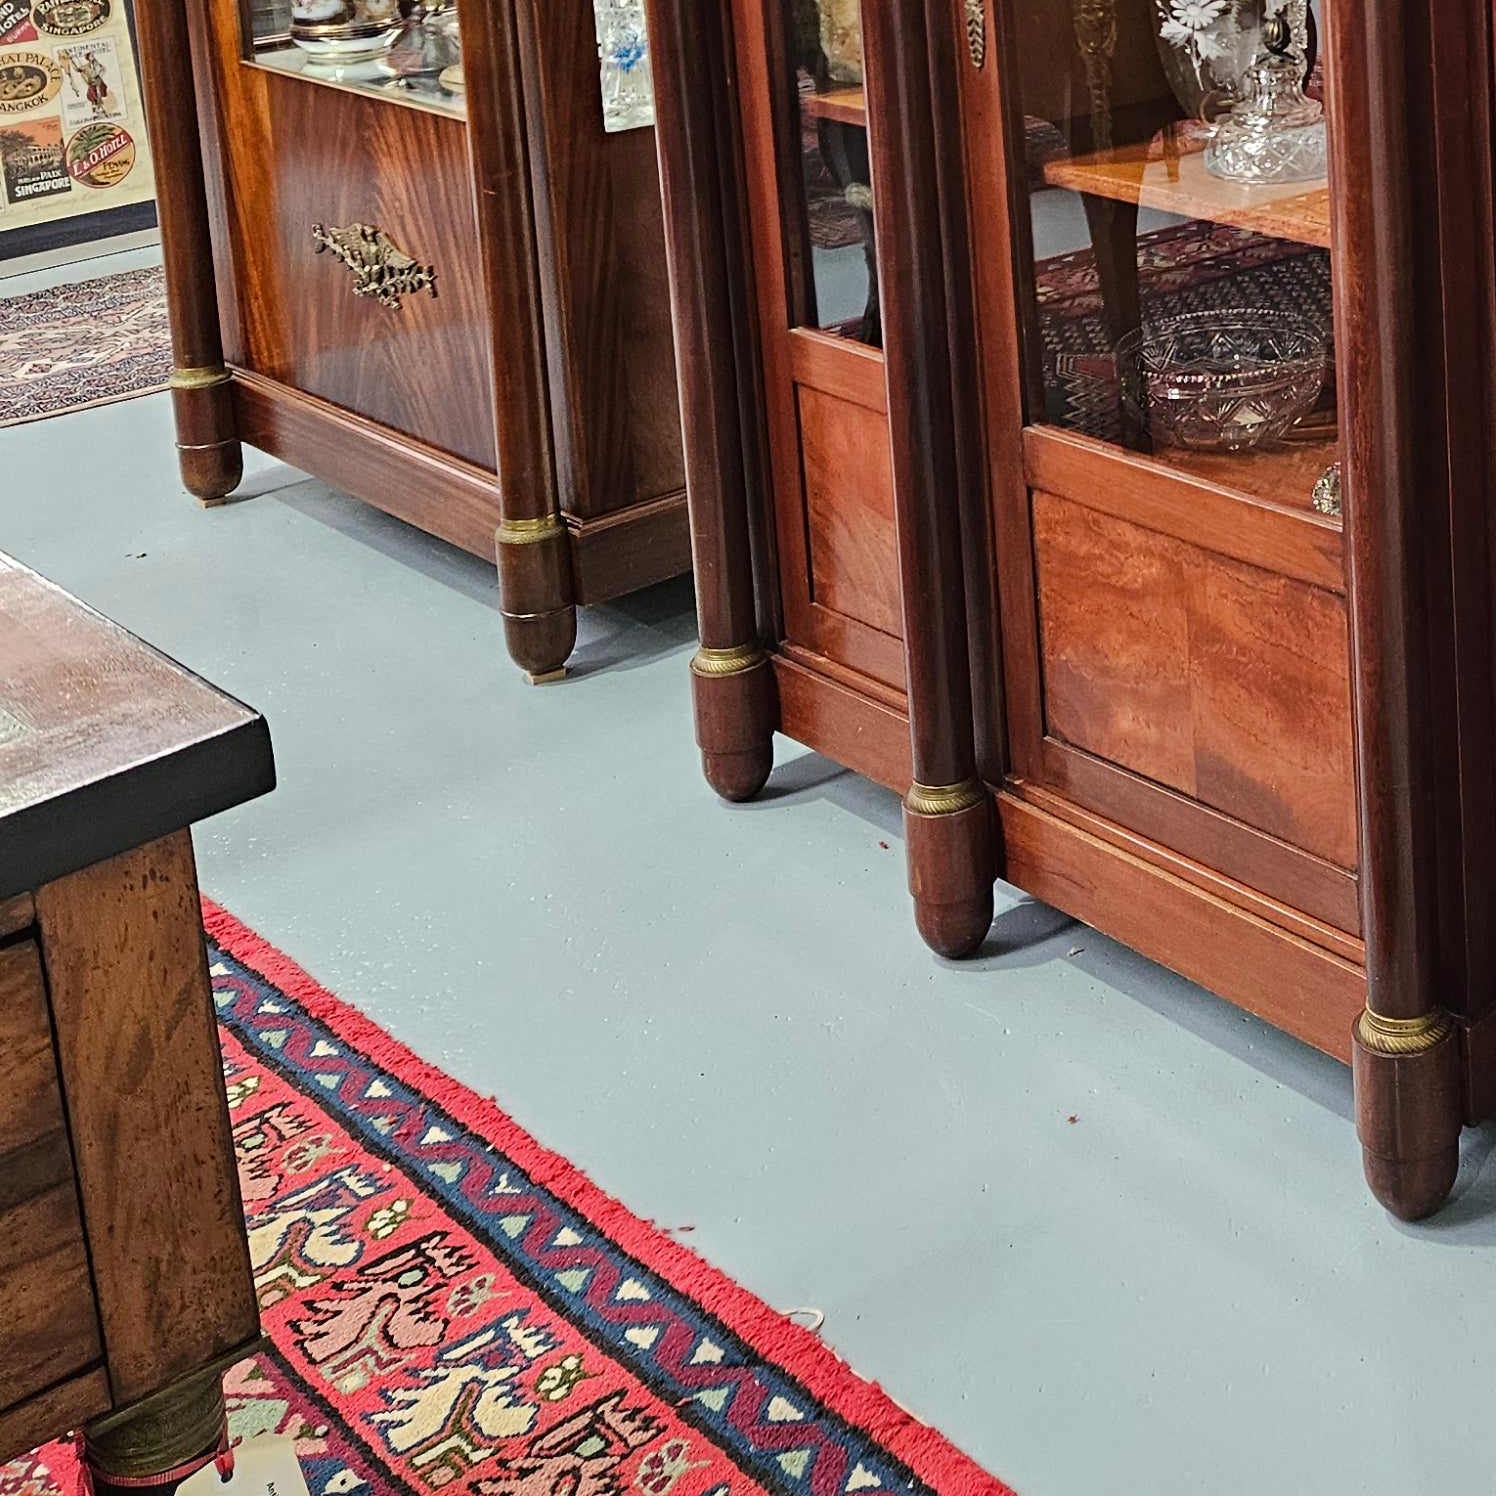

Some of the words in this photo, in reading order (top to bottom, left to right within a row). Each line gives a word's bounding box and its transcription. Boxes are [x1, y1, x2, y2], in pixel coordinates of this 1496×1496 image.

[40, 15, 107, 36] SINGAPORE
[26, 54, 61, 82] PALACE
[99, 134, 127, 159] HOTEL
[40, 169, 62, 181] PAIX
[15, 176, 71, 197] SINGAPORE
